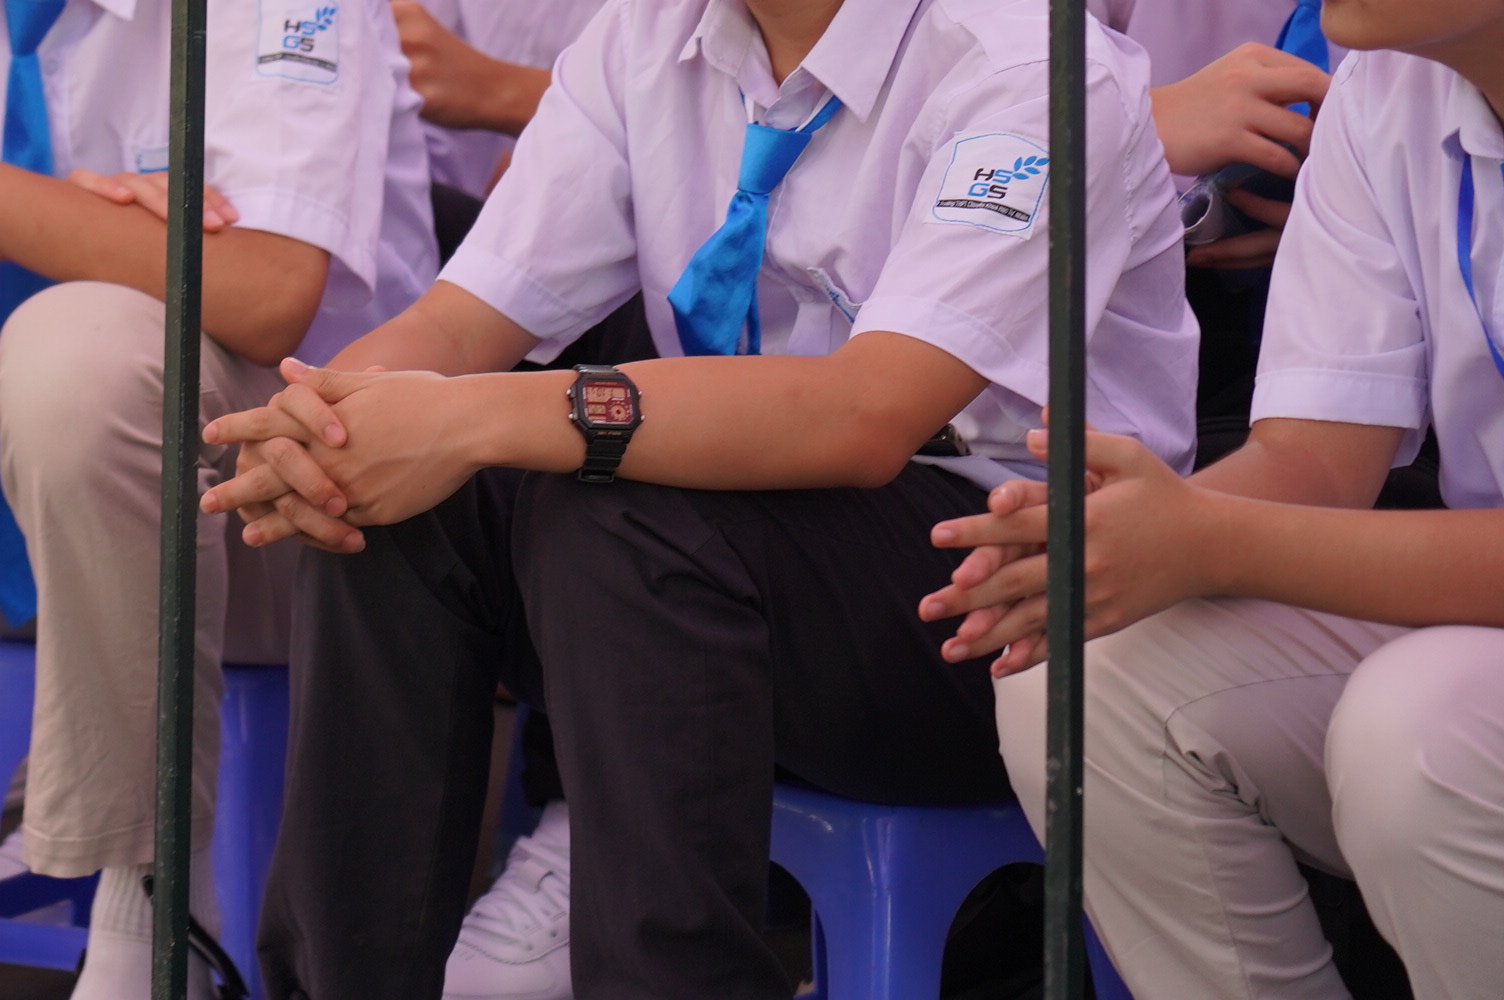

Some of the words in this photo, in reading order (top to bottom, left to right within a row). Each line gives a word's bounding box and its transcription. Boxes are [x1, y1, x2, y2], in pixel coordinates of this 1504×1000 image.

[283, 34, 315, 52] GS
[973, 167, 1014, 184] HS
[967, 182, 1008, 199] GS
